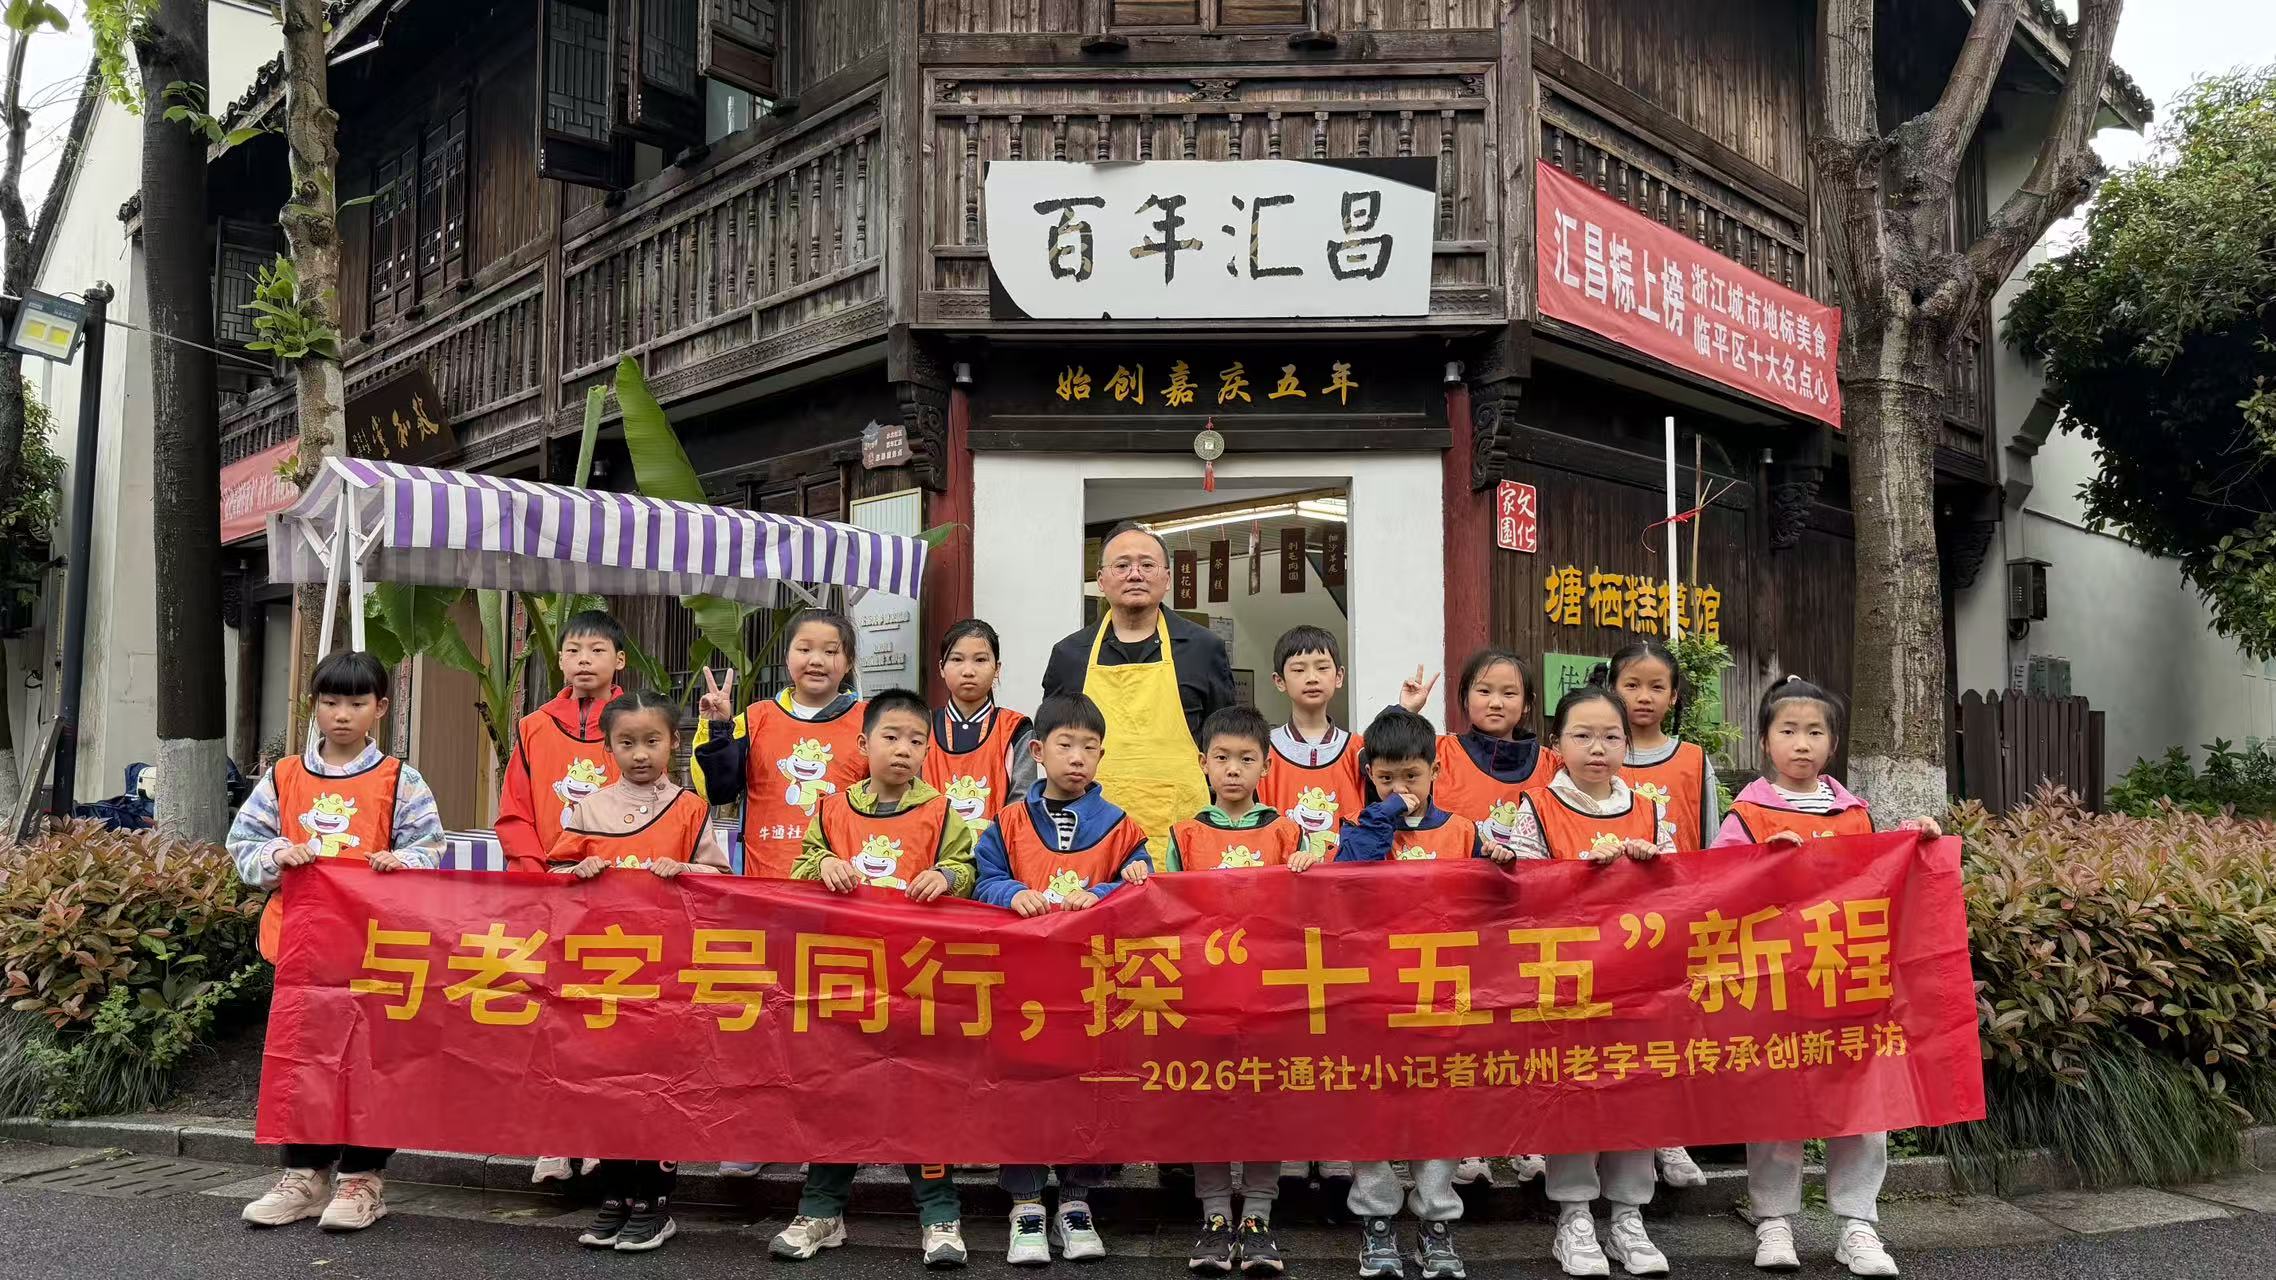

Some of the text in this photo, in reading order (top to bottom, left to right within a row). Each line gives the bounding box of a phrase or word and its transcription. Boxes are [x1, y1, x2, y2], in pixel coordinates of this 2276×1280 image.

[1033, 190, 1393, 287] 百年汇昌
[1554, 207, 1686, 337] 汇昌粽上榜
[1691, 261, 1827, 362] 浙江城市地标美食
[1056, 359, 1360, 408] 始创嘉庆五年
[1693, 314, 1830, 406] 临平区十大名点心
[759, 824, 803, 840] 牛通社
